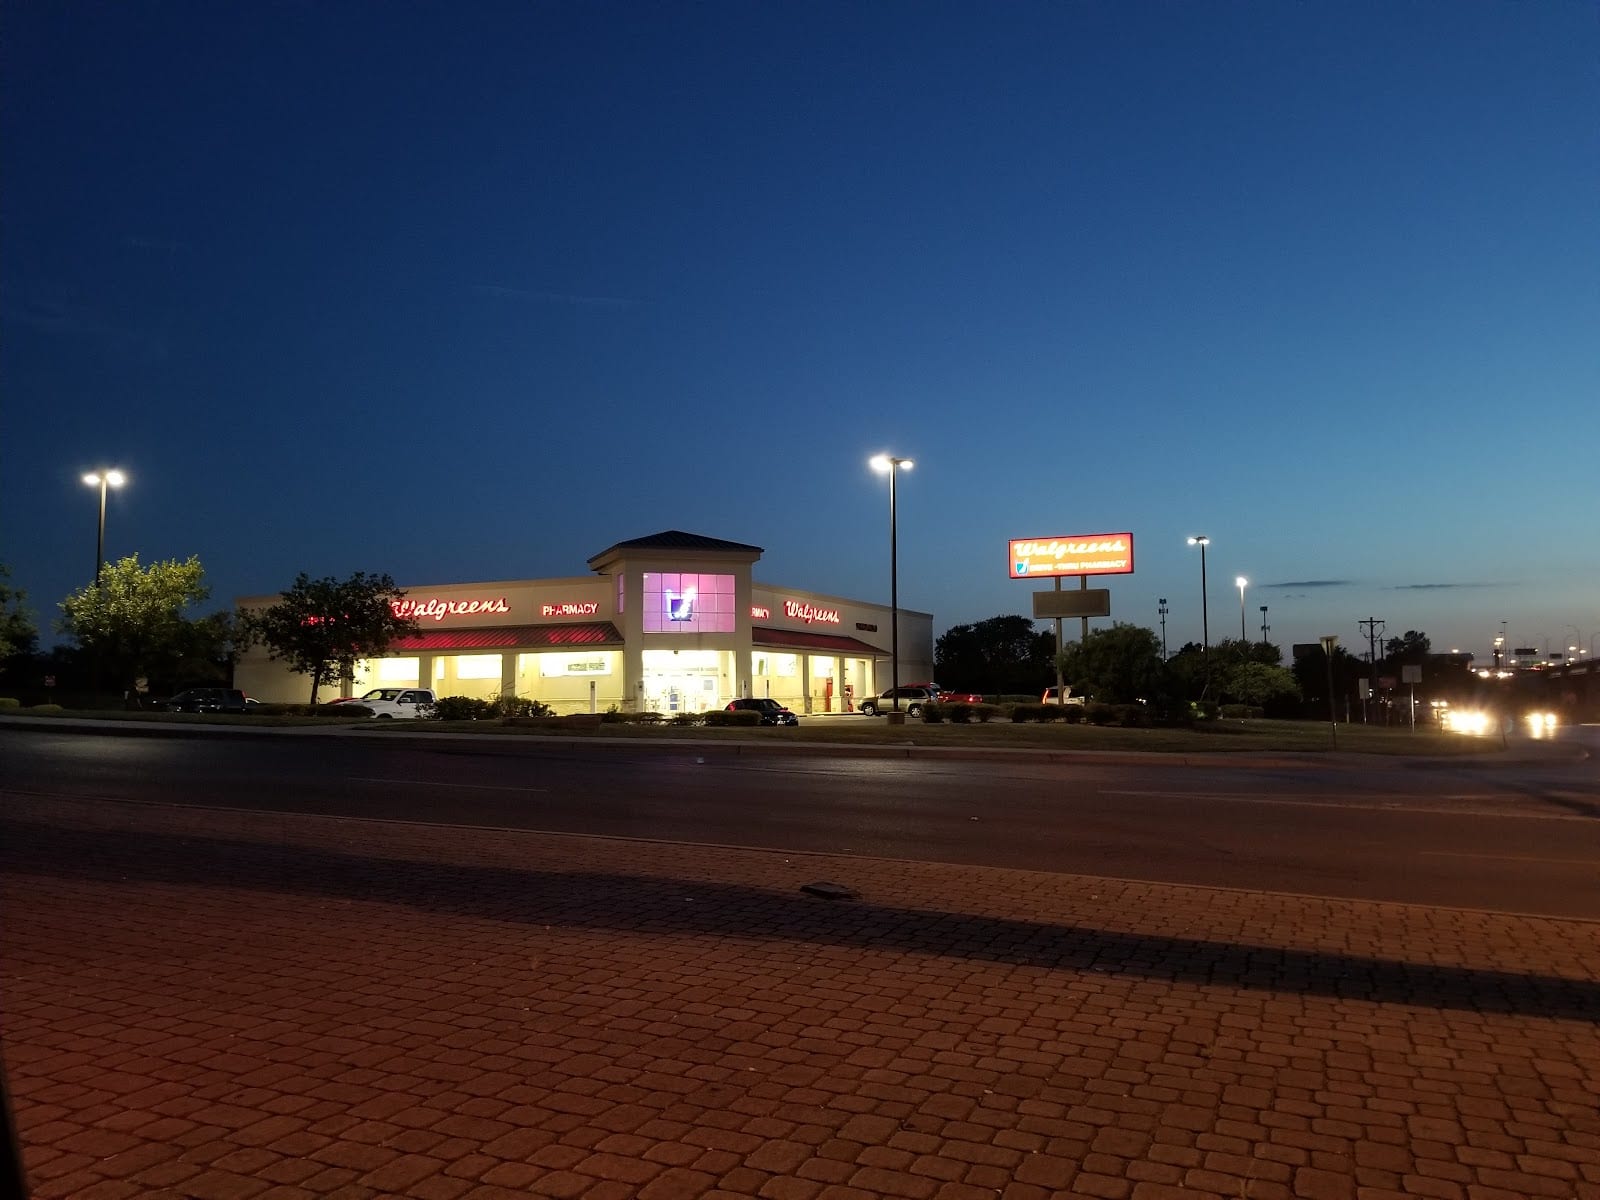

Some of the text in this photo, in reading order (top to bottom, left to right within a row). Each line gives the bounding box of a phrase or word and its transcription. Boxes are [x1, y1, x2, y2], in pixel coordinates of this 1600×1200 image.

[1013, 540, 1126, 559] Walgreens
[391, 598, 510, 621] Walgreens
[543, 603, 600, 616] PHARMACY
[784, 601, 841, 624] Walgreens
